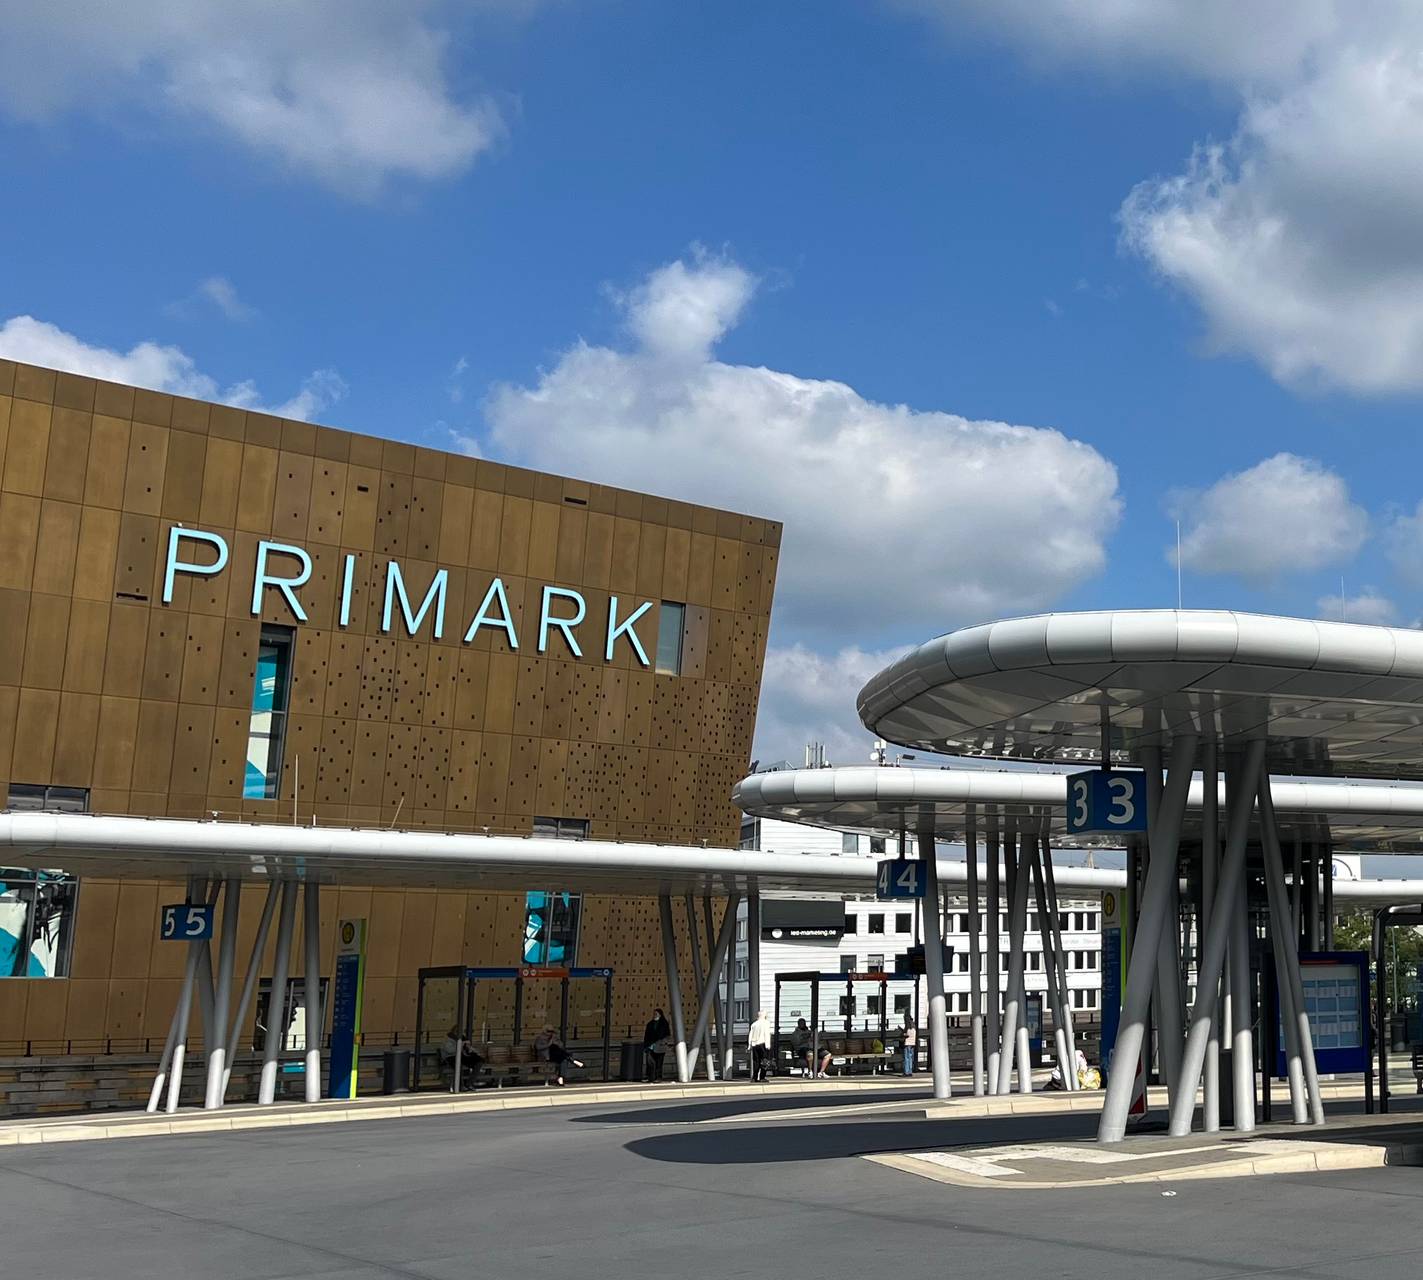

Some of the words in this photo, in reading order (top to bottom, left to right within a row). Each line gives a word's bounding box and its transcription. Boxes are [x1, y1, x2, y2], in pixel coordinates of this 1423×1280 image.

[162, 526, 654, 666] PRIMARK
[1073, 779, 1088, 827] 3
[1107, 777, 1135, 824] 3
[879, 863, 888, 894] 4
[896, 863, 918, 893] 4
[164, 908, 176, 937] 5
[185, 908, 206, 936] 5
